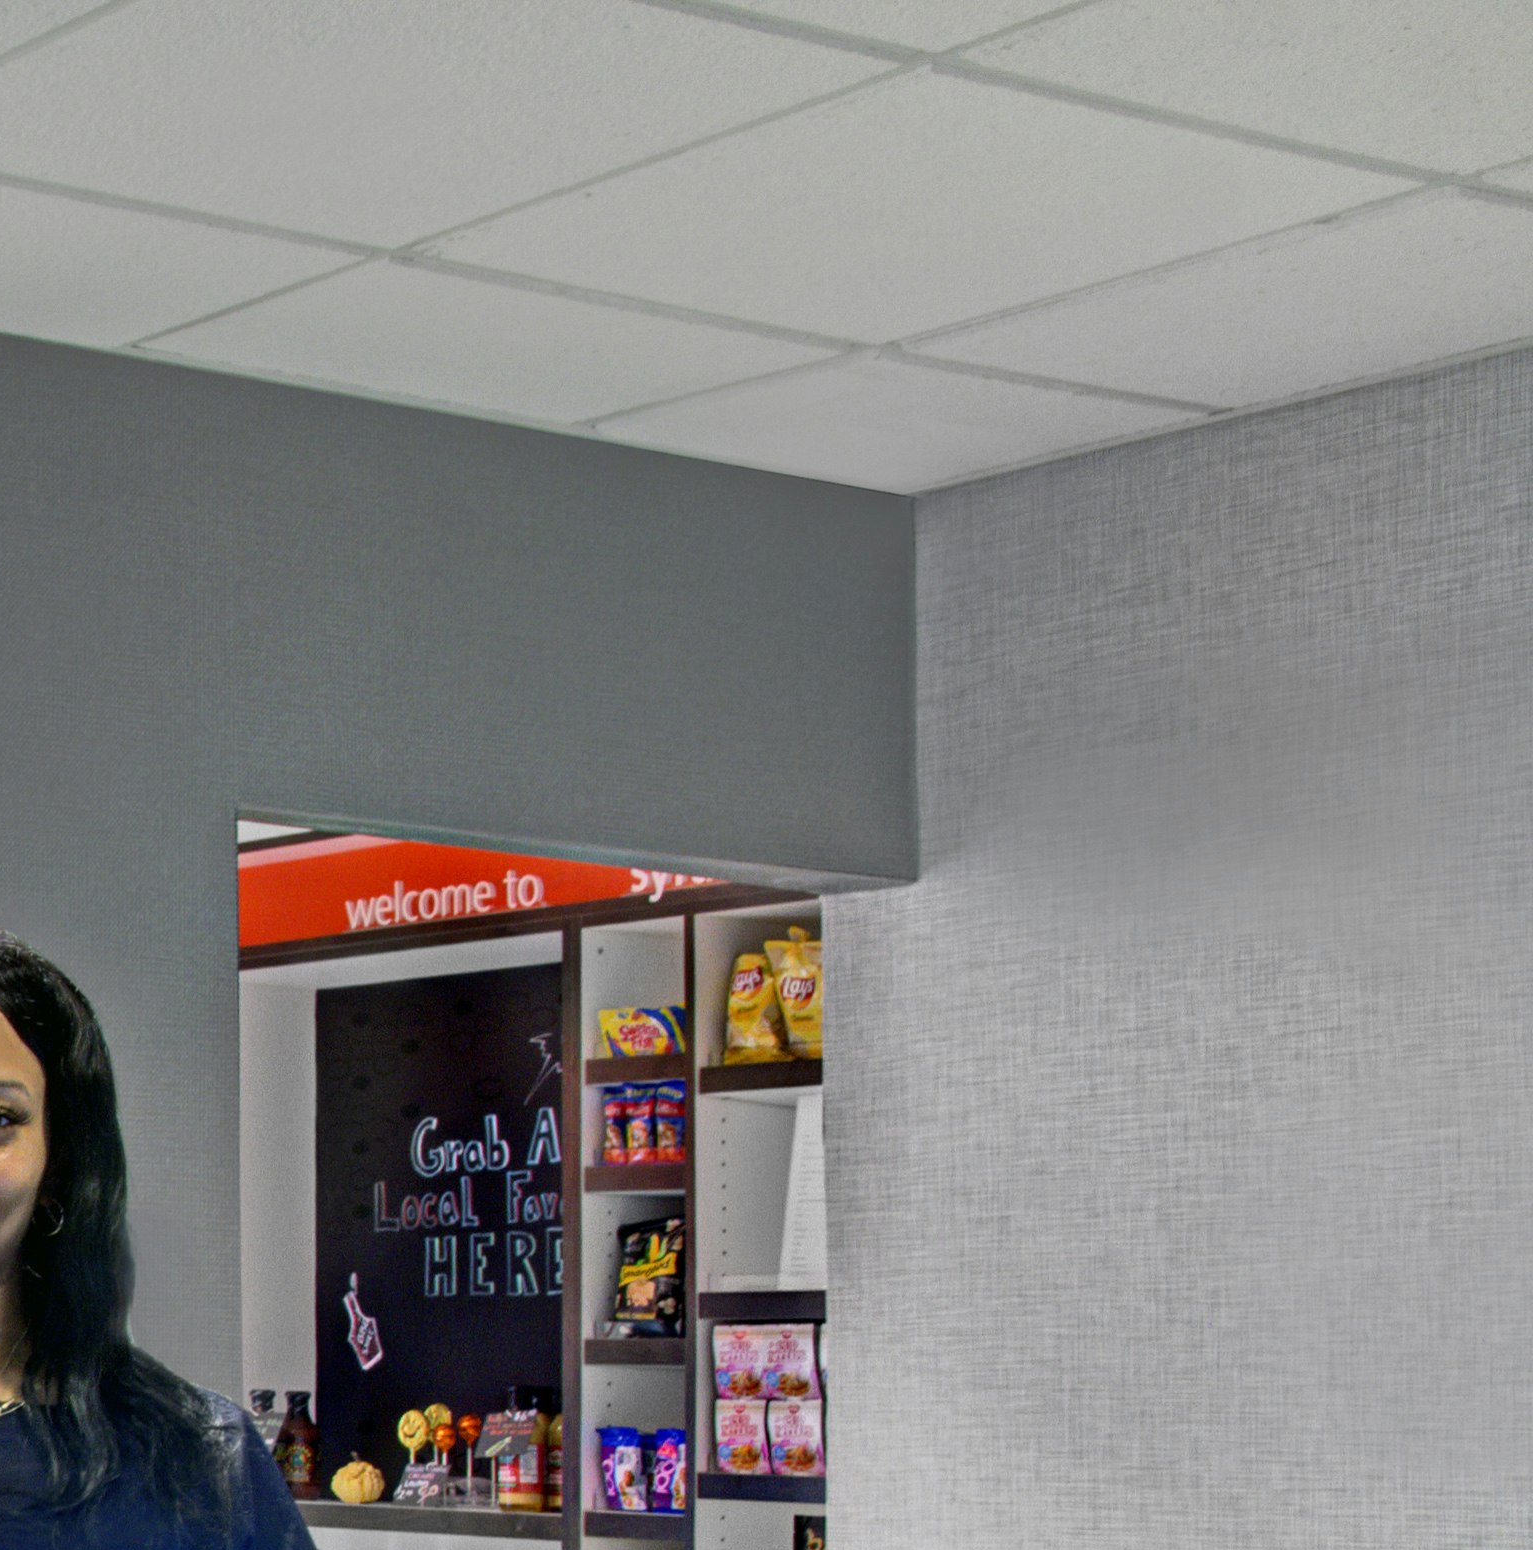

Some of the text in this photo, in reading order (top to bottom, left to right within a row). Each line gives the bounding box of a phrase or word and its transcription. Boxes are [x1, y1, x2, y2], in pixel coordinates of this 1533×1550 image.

[345, 869, 544, 930] welcome to
[410, 1106, 562, 1178] Grab A
[506, 1170, 563, 1224] Fav
[425, 1227, 563, 1296] HERE
